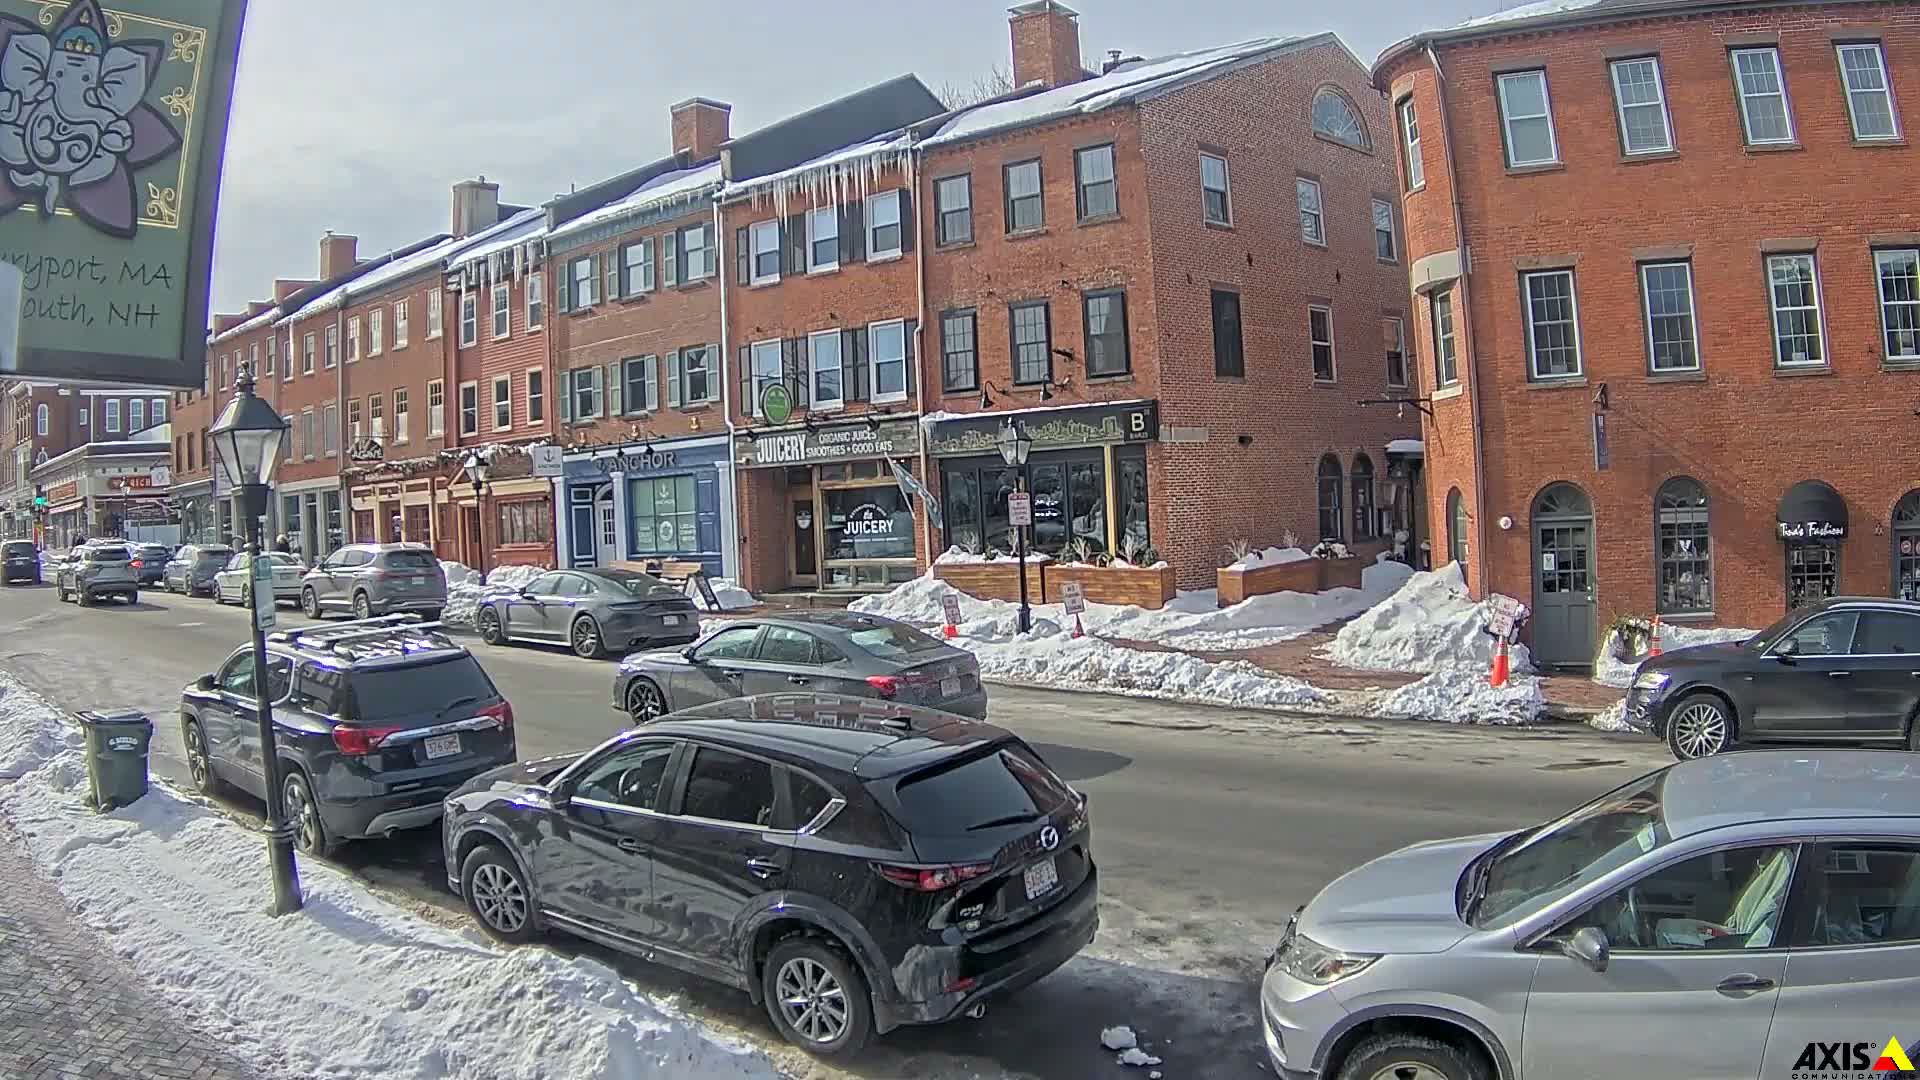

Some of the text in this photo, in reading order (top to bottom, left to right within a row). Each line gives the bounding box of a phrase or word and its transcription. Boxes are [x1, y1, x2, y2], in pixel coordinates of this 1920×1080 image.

[119, 261, 172, 288] MA
[109, 301, 160, 328] NH
[1131, 412, 1145, 431] B
[818, 429, 877, 444] ORGANIC JUICES
[757, 433, 806, 462] JUICERY
[852, 442, 874, 454] GOOD
[875, 440, 893, 453] EATS
[608, 452, 674, 473] ANCHOR
[843, 519, 894, 535] JUICERY
